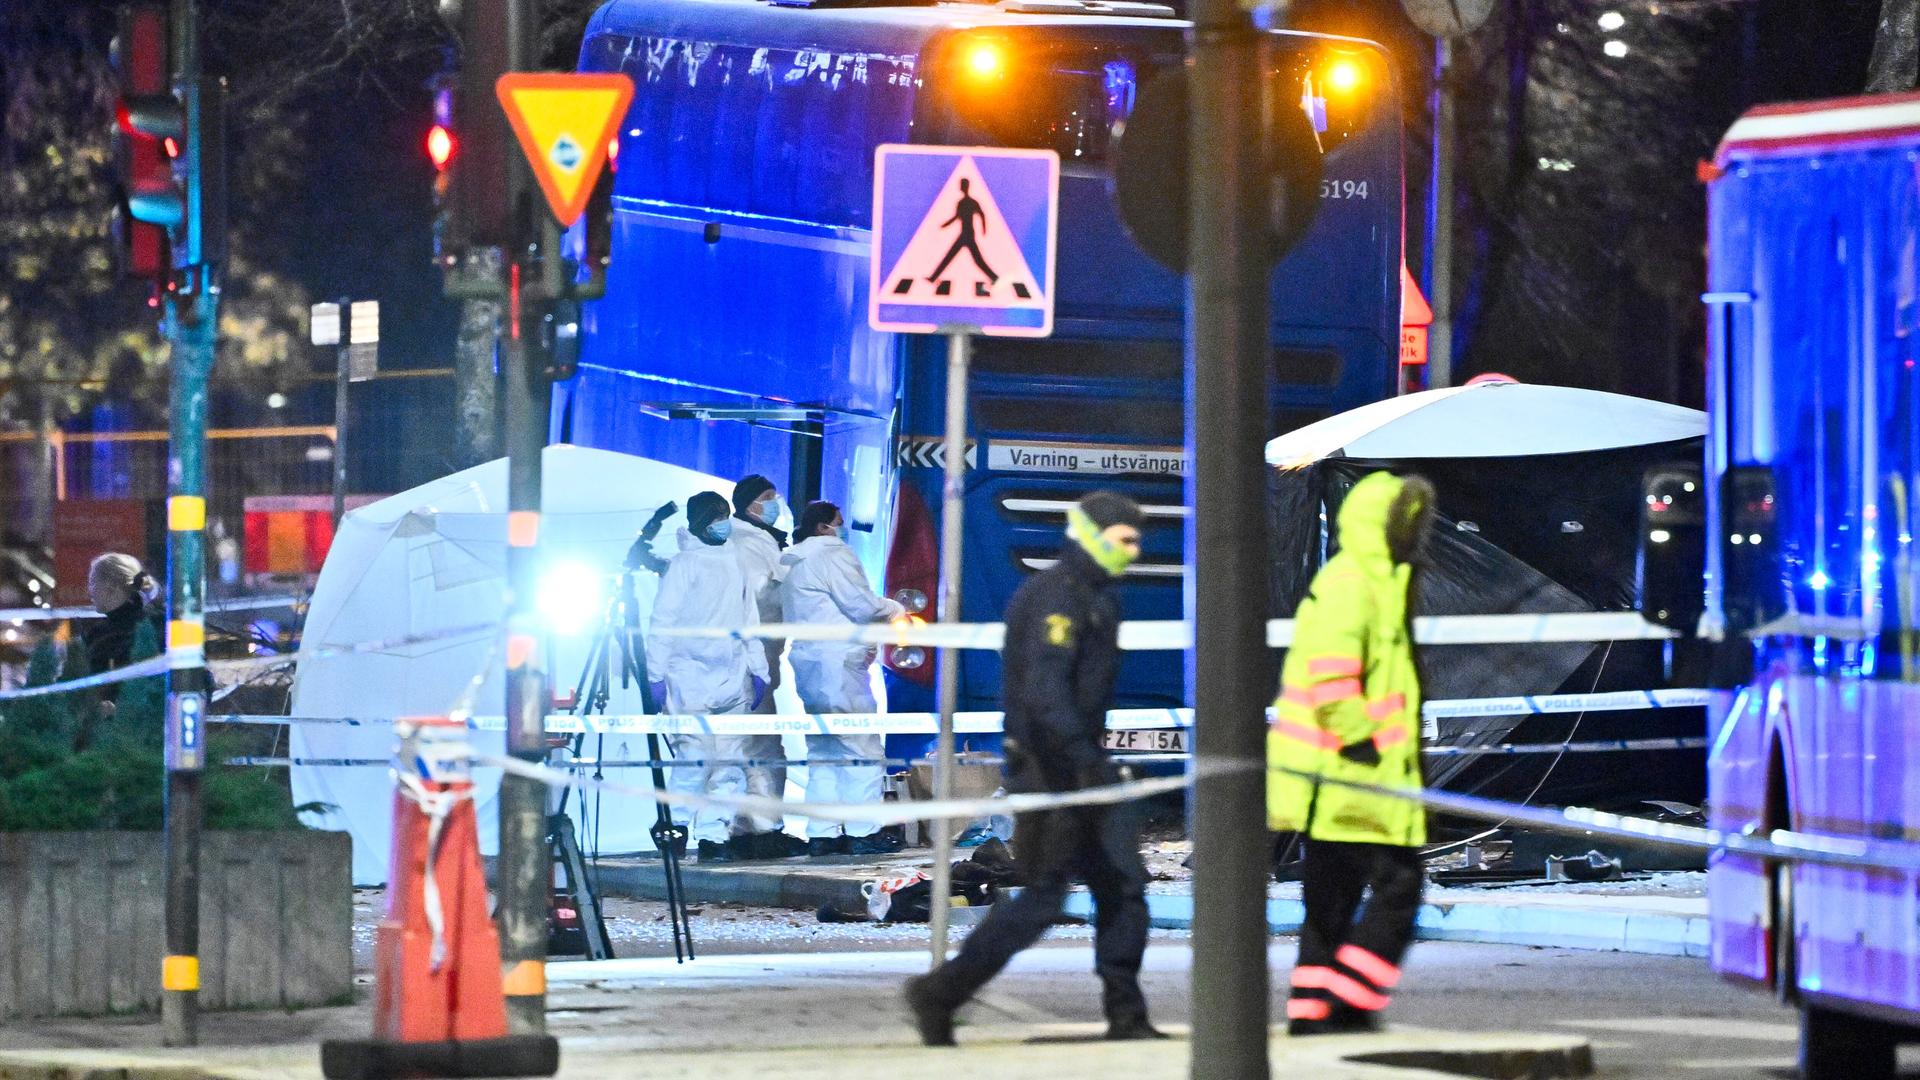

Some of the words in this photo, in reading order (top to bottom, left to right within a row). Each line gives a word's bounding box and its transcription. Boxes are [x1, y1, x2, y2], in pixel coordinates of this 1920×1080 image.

[1319, 180, 1368, 199] 5194
[1010, 448, 1078, 469] Varning
[833, 718, 870, 727] POLIS
